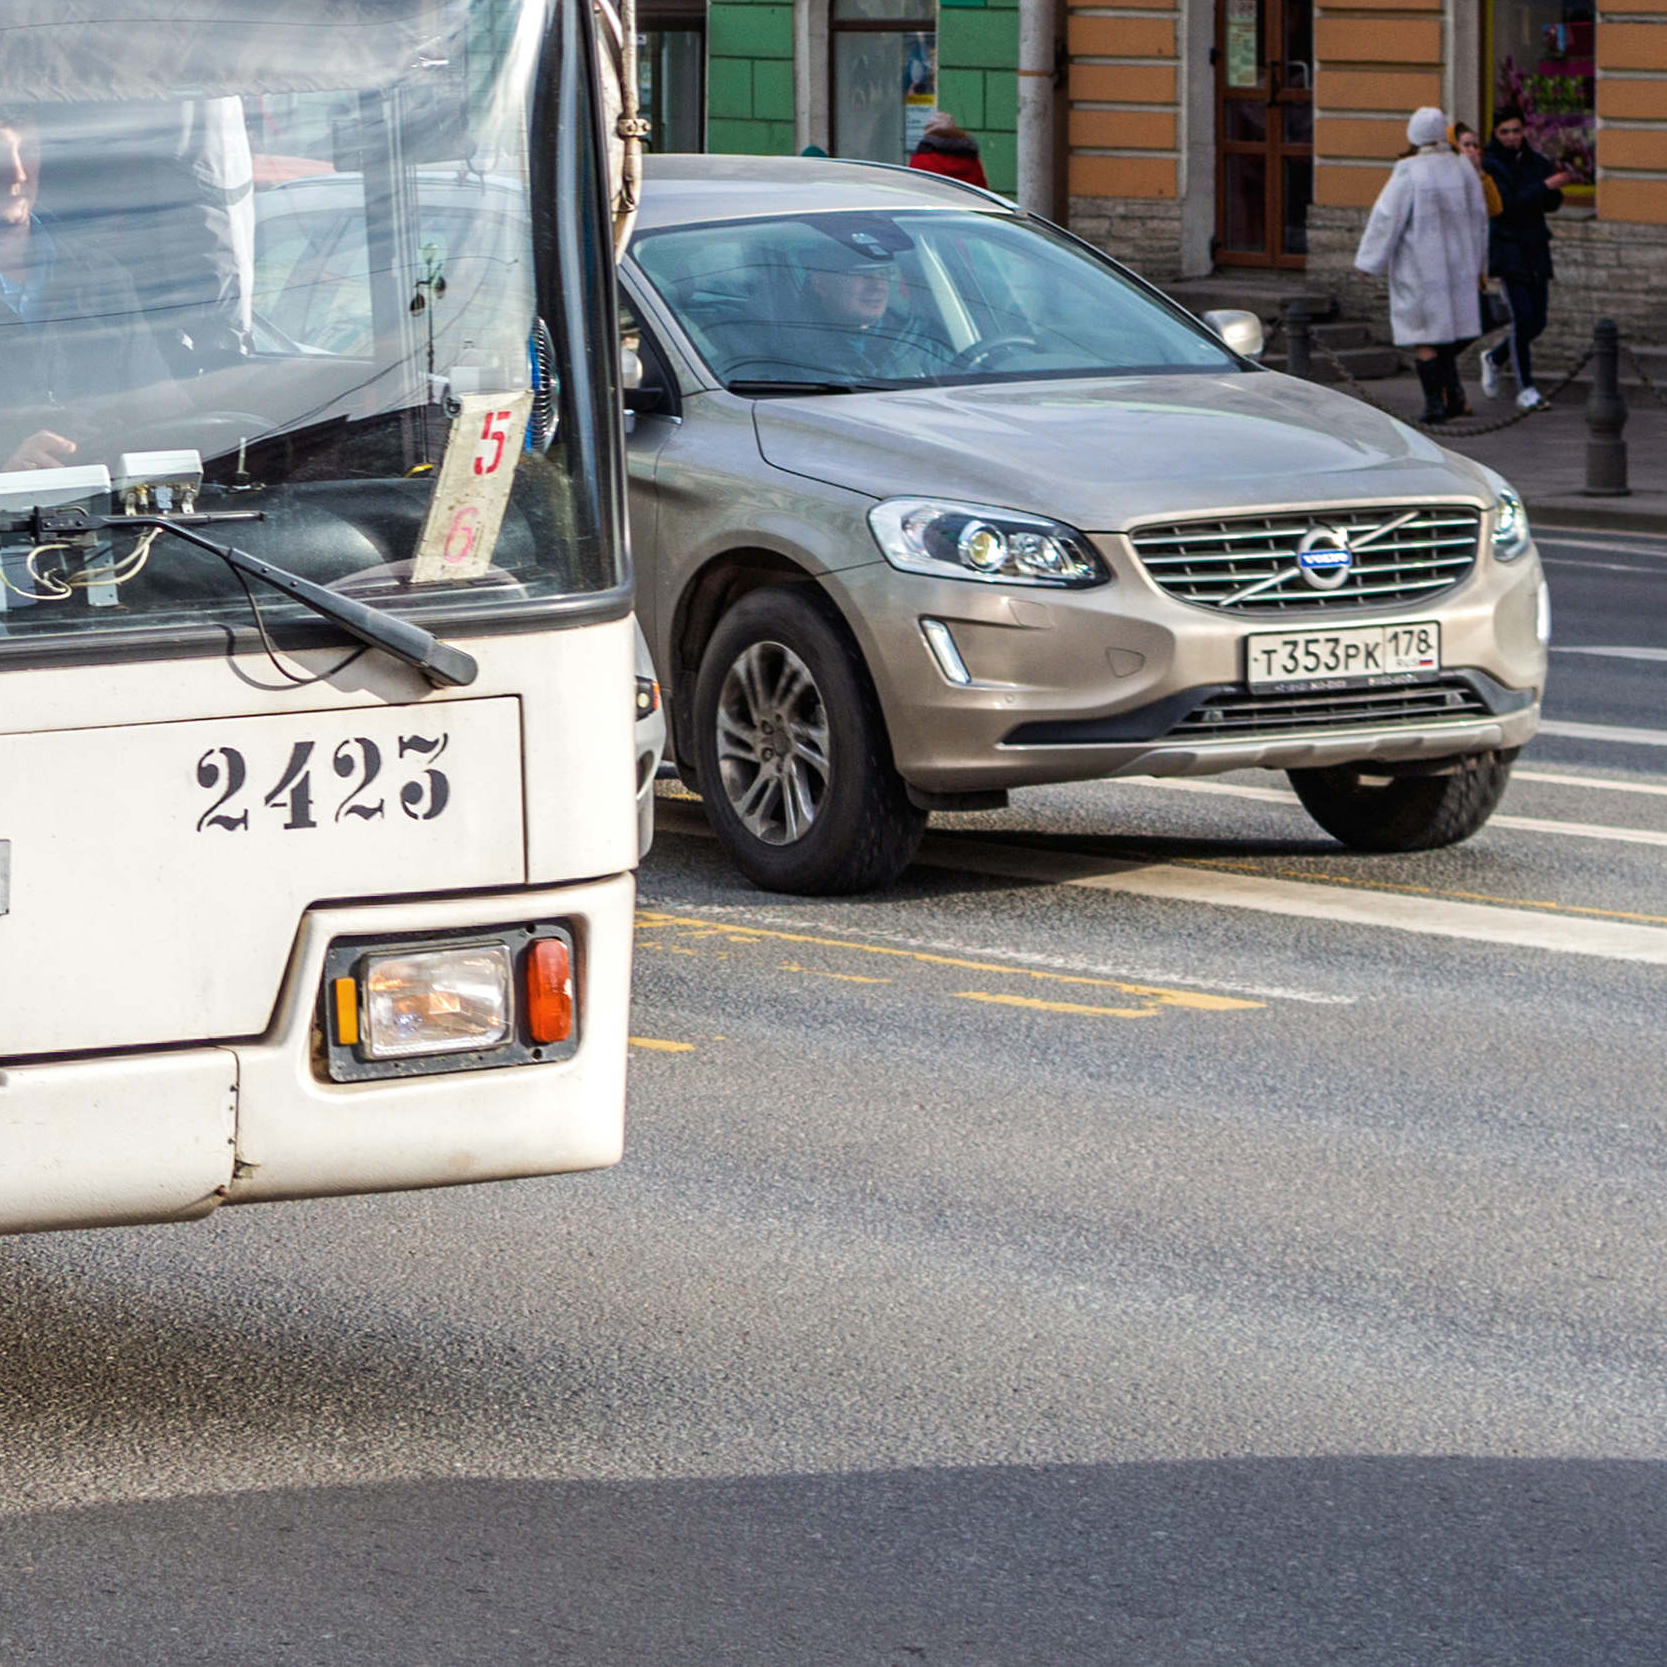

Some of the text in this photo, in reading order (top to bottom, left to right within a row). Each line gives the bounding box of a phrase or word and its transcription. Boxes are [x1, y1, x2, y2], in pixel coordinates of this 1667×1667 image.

[473, 410, 512, 475] 5
[443, 506, 480, 563] 6
[1303, 552, 1349, 565] VOLVO
[1261, 629, 1430, 676] Т353РК 178
[196, 732, 451, 832] 2423
